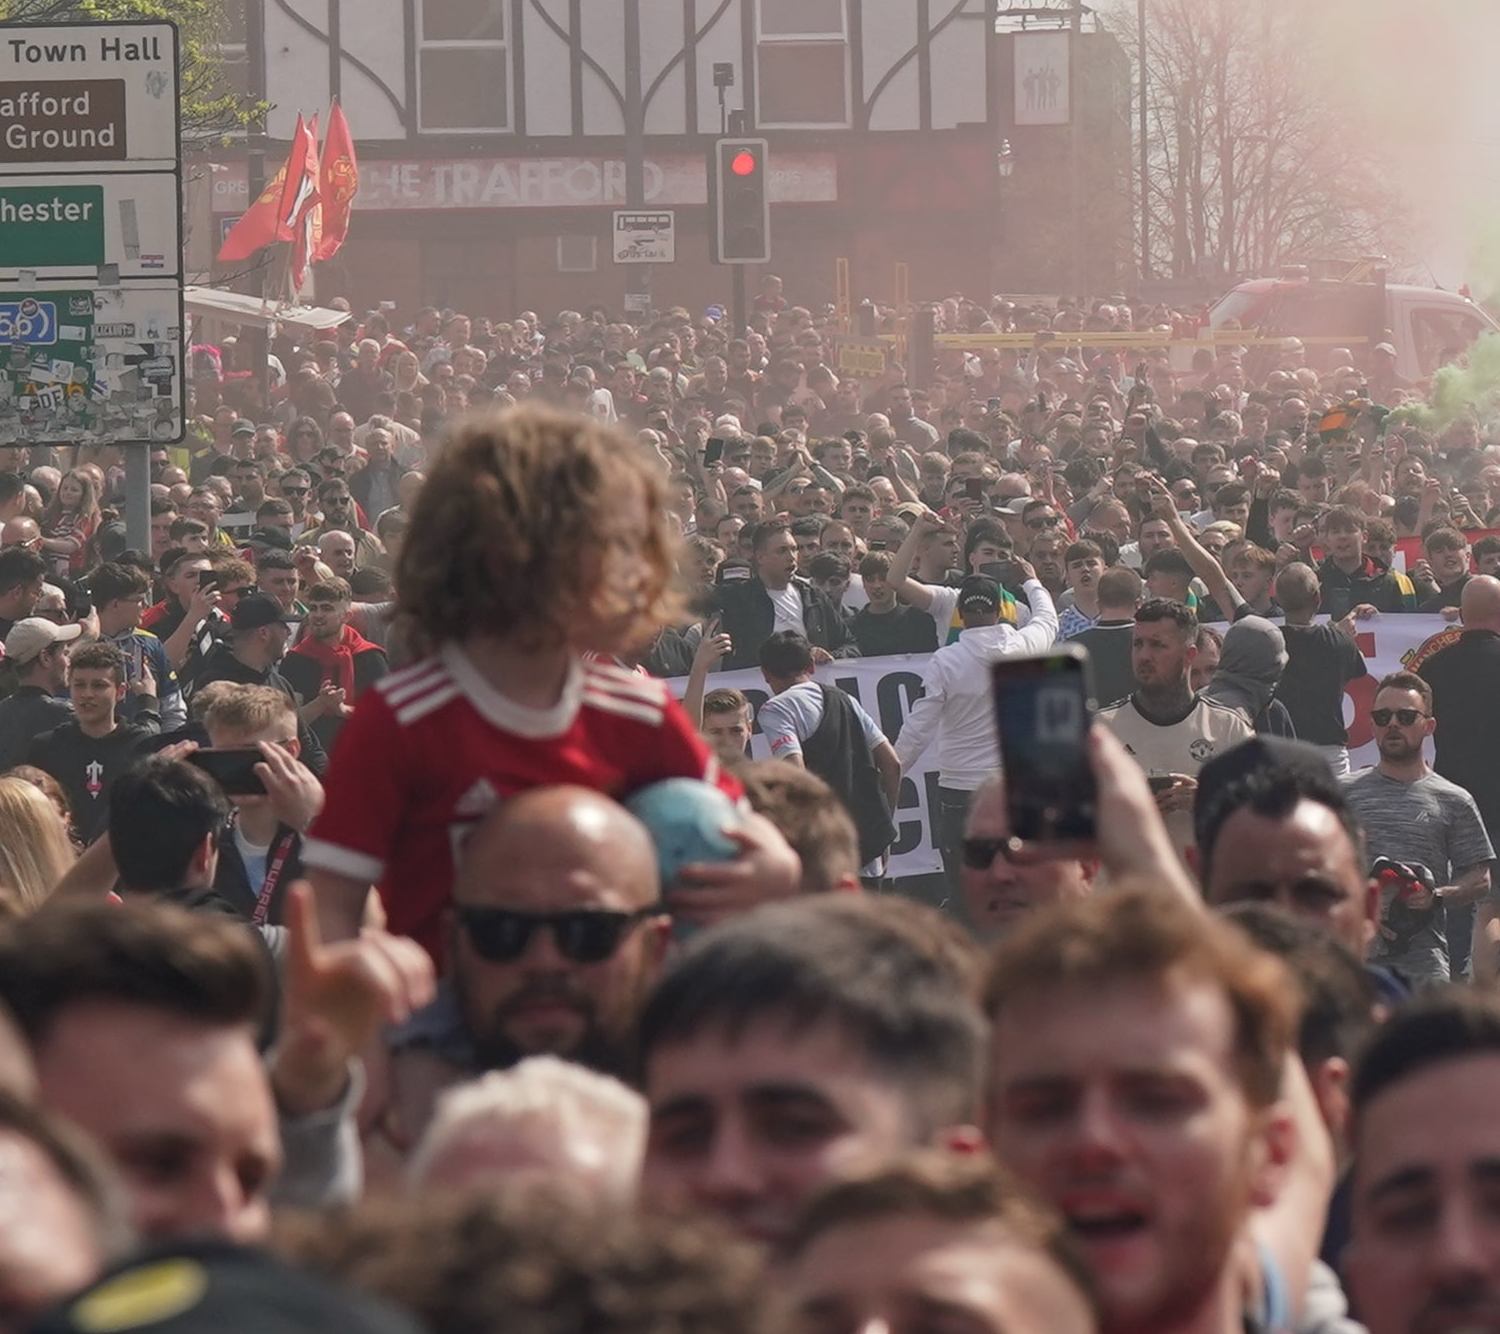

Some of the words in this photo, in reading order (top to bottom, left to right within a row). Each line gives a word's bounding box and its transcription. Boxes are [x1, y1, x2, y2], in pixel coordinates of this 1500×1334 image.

[8, 39, 87, 63] Town
[100, 37, 161, 62] Hall
[5, 123, 116, 150] Ground
[430, 160, 664, 205] TRAFFORD
